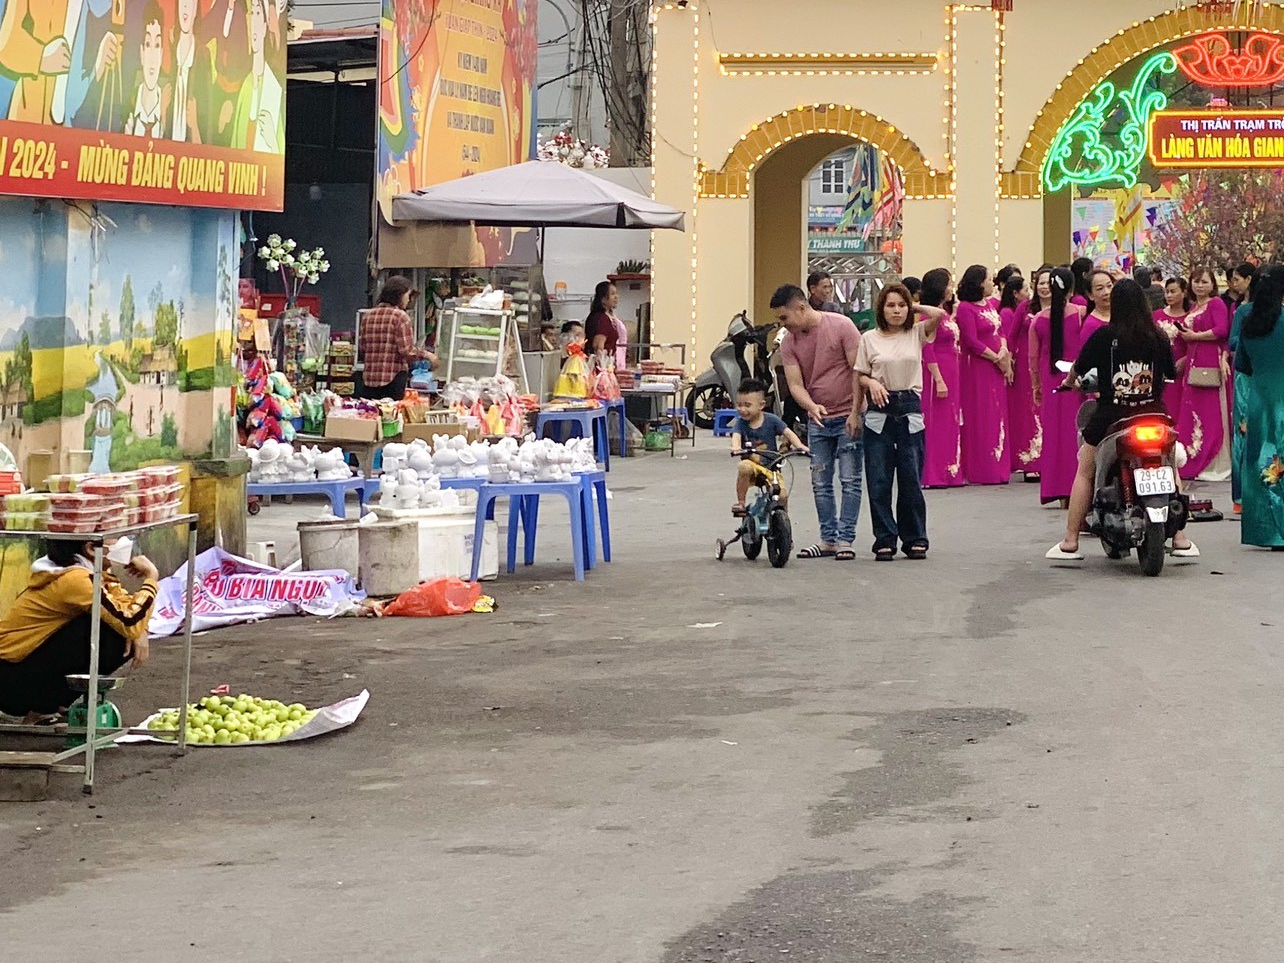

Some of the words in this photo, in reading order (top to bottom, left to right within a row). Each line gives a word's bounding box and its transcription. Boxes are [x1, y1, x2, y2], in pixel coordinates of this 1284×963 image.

[1181, 119, 1199, 133] THỊ
[1201, 116, 1231, 130] TRẤN
[1234, 119, 1265, 132] TRẠM
[1161, 133, 1194, 159] LÀNG
[1197, 133, 1222, 158] VĂN
[1226, 133, 1251, 158] HÓA
[9, 138, 56, 180] 2024
[77, 139, 128, 186] MỪNG
[131, 141, 175, 189] ĐẢNG
[177, 155, 225, 195] QUANG
[228, 162, 259, 196] VINH
[1141, 470, 1167, 481] 29-C2
[1139, 481, 1172, 494] 091.63
